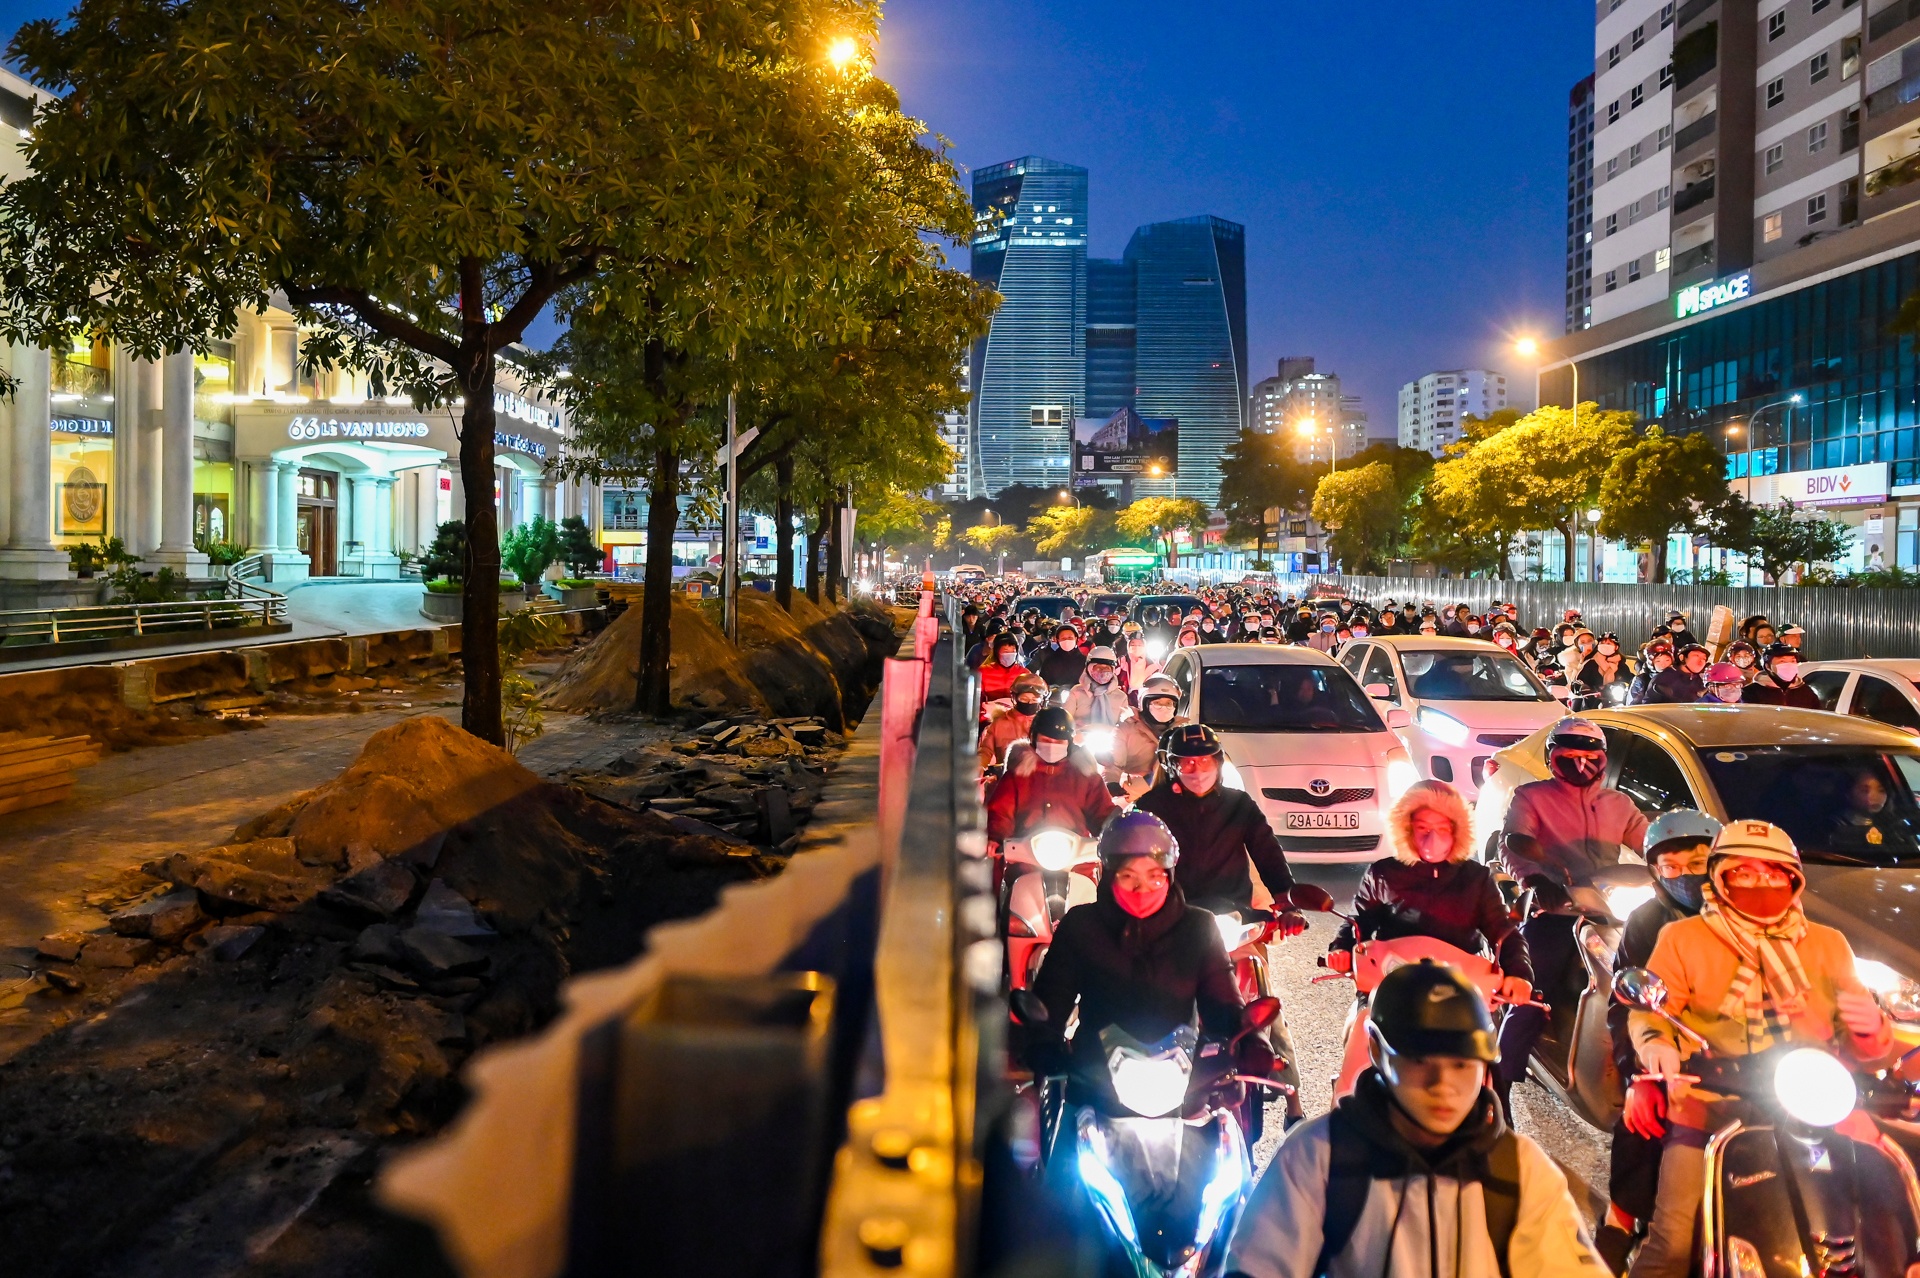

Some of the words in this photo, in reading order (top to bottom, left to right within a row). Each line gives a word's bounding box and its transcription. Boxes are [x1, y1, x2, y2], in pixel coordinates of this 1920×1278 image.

[289, 416, 320, 439] 66
[1807, 475, 1837, 494] BIDV
[1290, 814, 1356, 827] 29A-041.16
